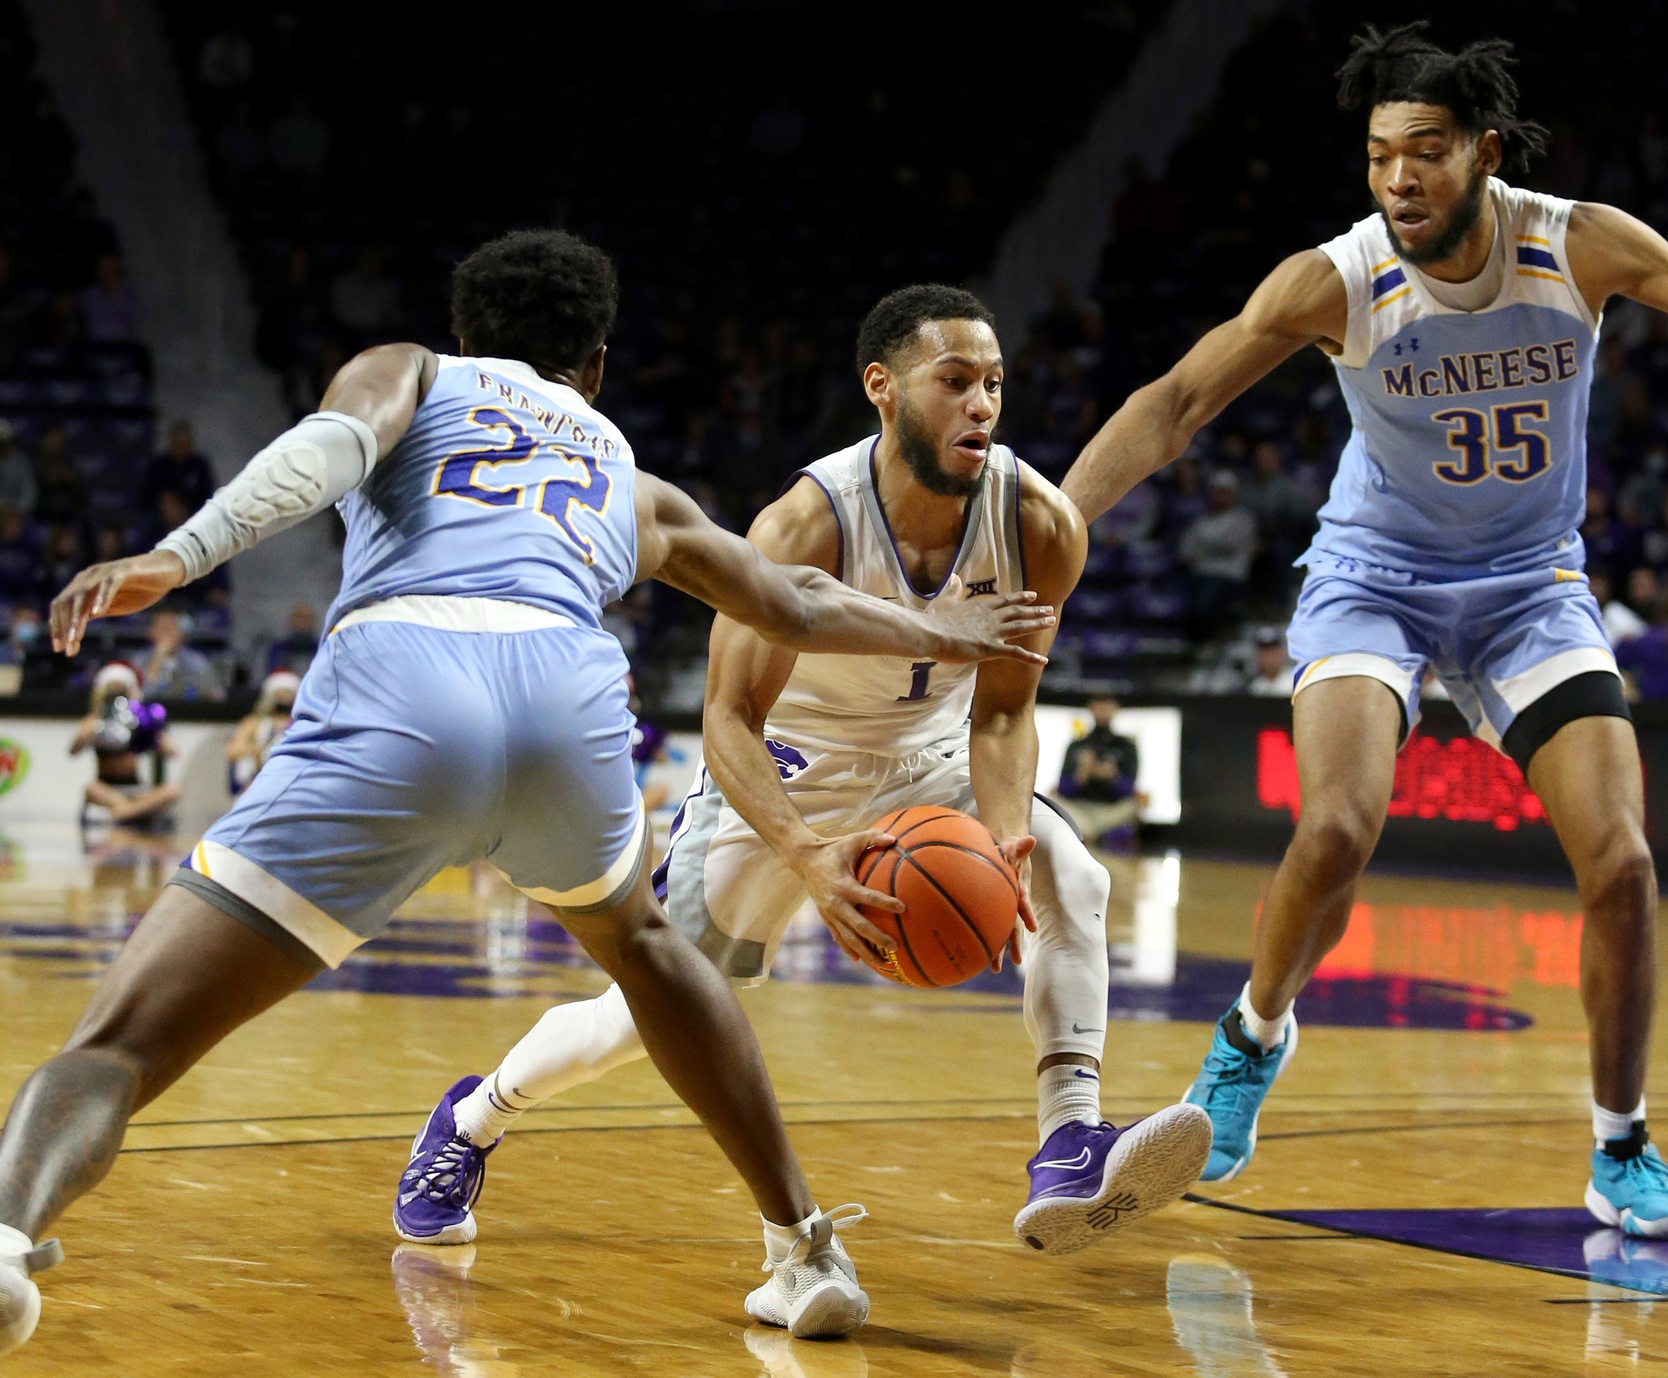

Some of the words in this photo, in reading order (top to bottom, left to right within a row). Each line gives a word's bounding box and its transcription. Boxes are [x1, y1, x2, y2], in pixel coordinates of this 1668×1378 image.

[1382, 338, 1580, 398] McNEESE
[1431, 400, 1553, 487] 35
[430, 405, 613, 567] 22
[965, 576, 998, 601] XII
[895, 661, 938, 702] 1
